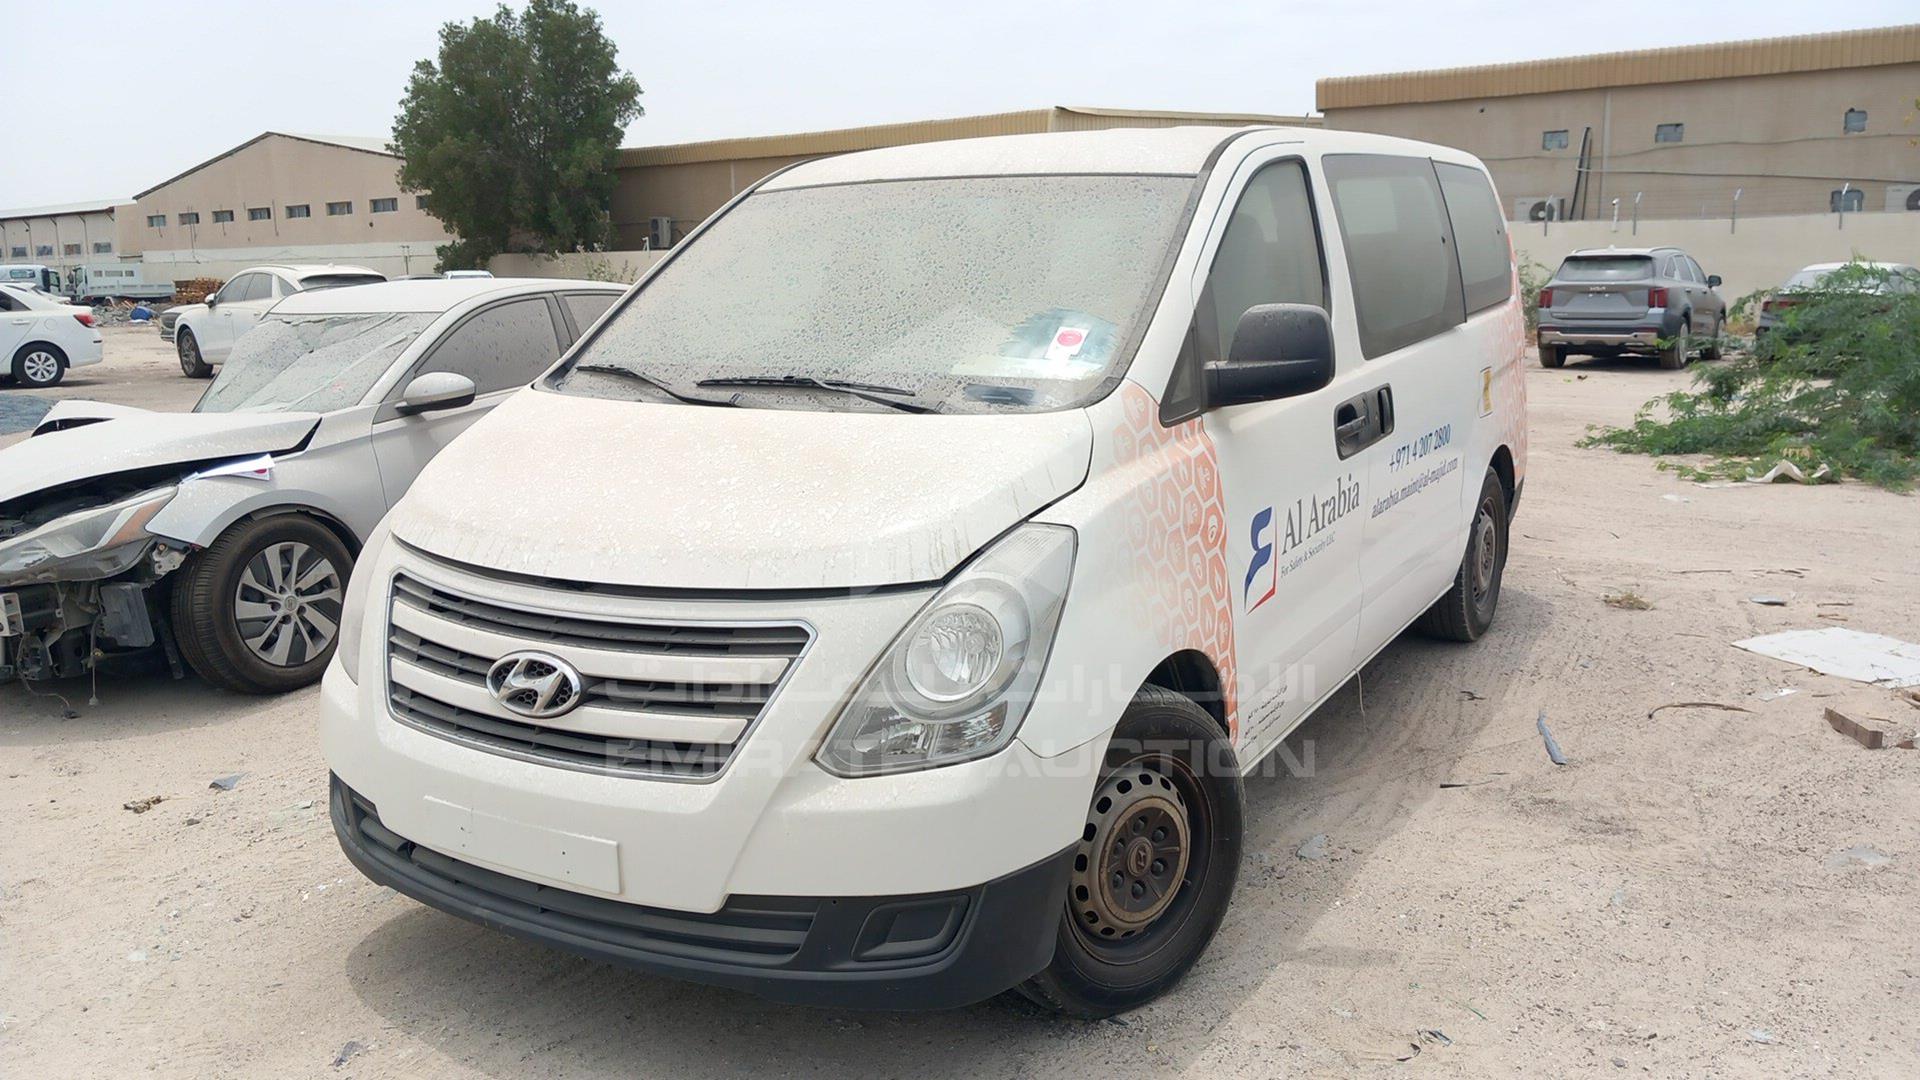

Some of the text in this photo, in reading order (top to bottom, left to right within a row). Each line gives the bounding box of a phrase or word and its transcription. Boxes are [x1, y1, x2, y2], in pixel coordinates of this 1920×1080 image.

[1389, 424, 1451, 473] +971 4 207 2800
[1282, 473, 1360, 555] Al Arabia
